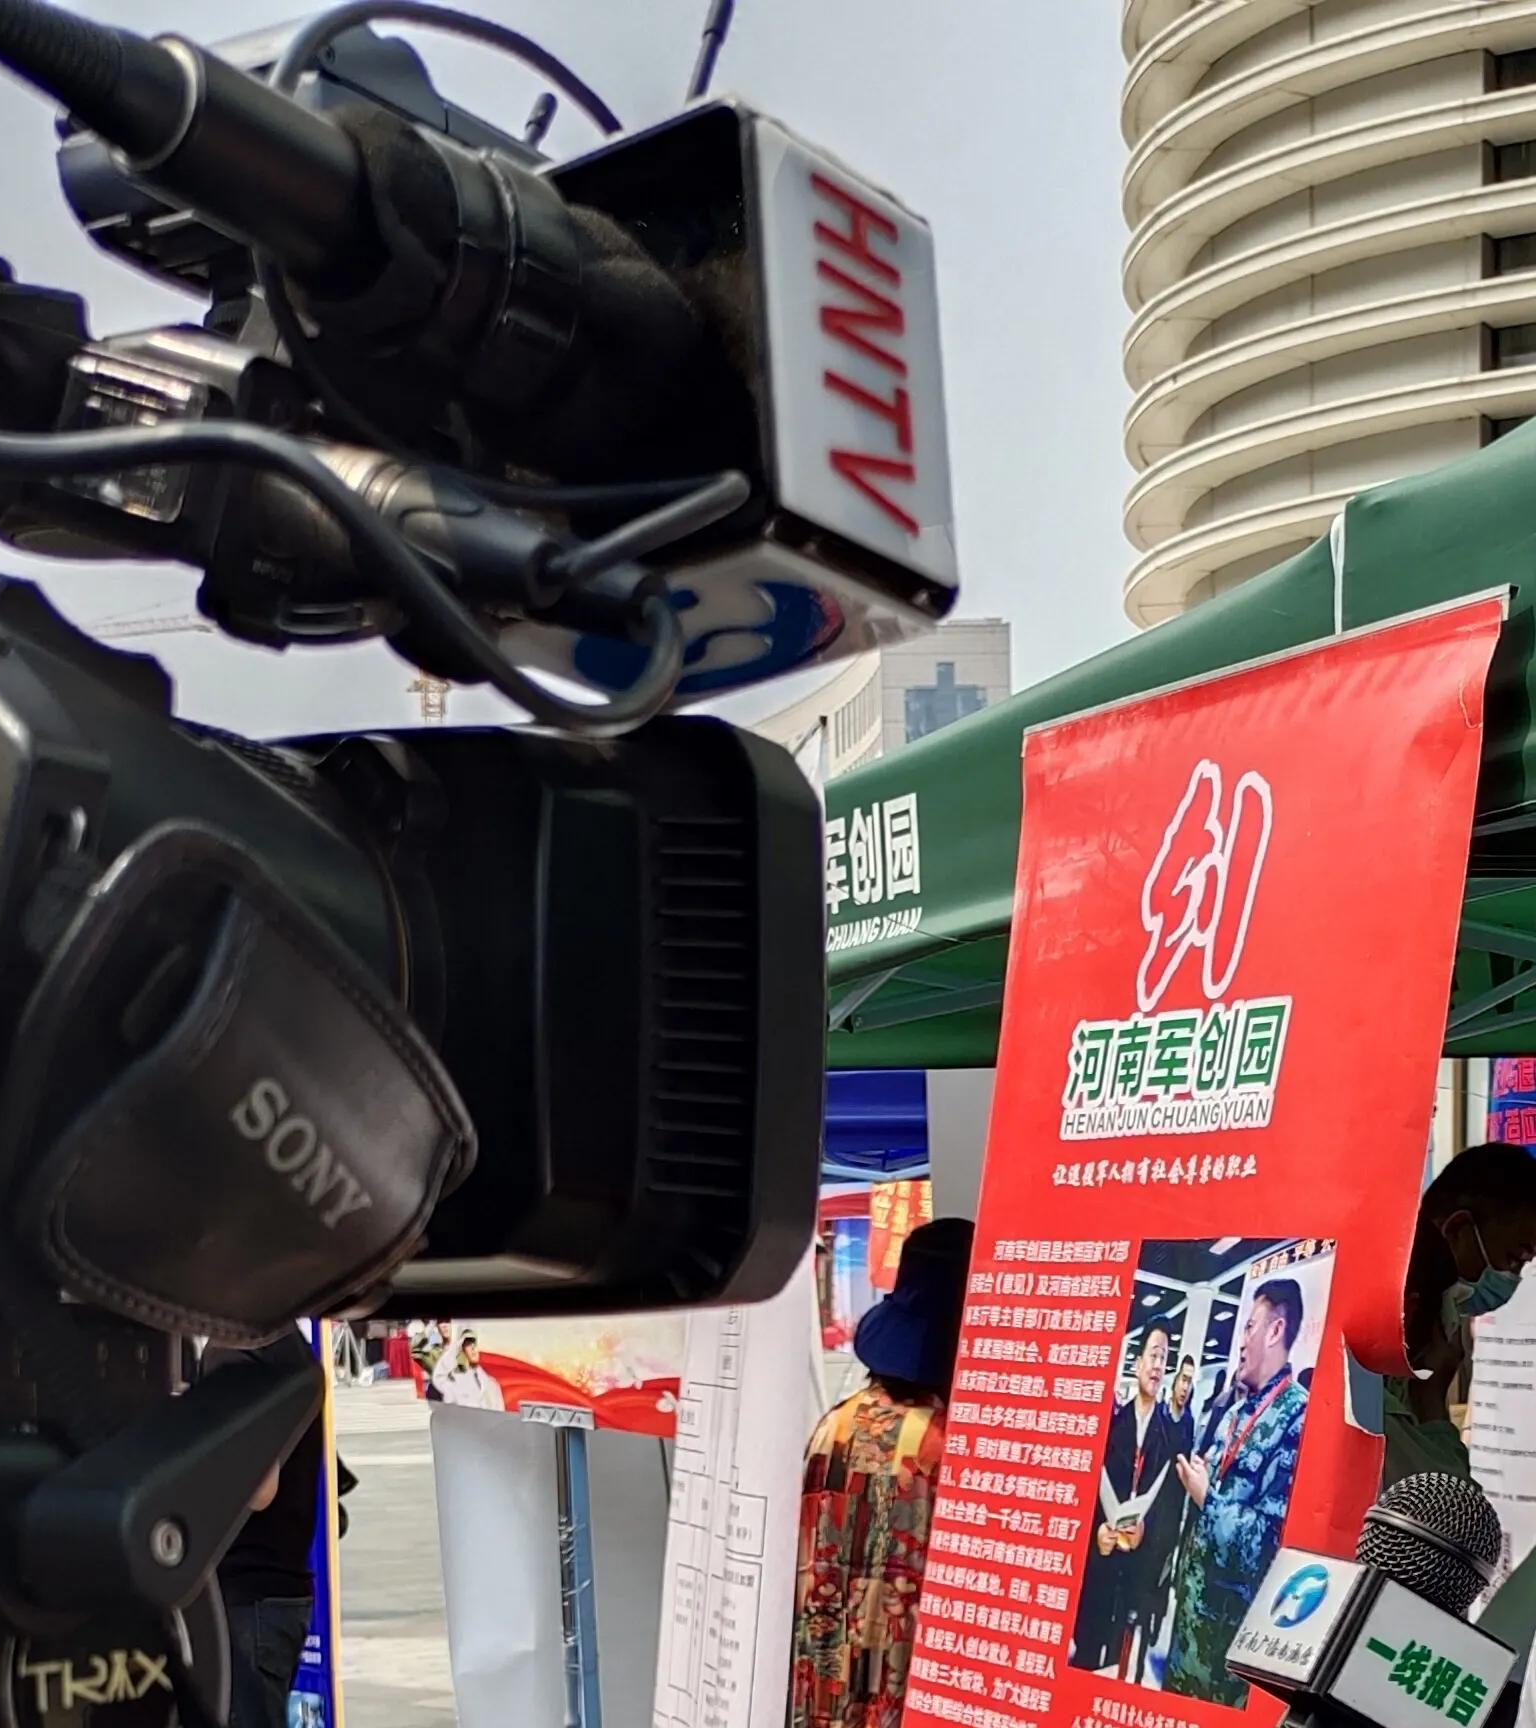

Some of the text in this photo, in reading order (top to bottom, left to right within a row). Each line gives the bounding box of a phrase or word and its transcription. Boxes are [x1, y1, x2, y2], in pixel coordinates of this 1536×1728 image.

[810, 171, 921, 539] HNTV
[1067, 1004, 1287, 1104] 河南军创园
[230, 1077, 372, 1228] SONY
[1064, 1112, 1115, 1134] HENAN
[1151, 1103, 1220, 1128] CHUANG
[1223, 1098, 1270, 1123] YUAN
[1366, 1637, 1489, 1728] 一线报告
